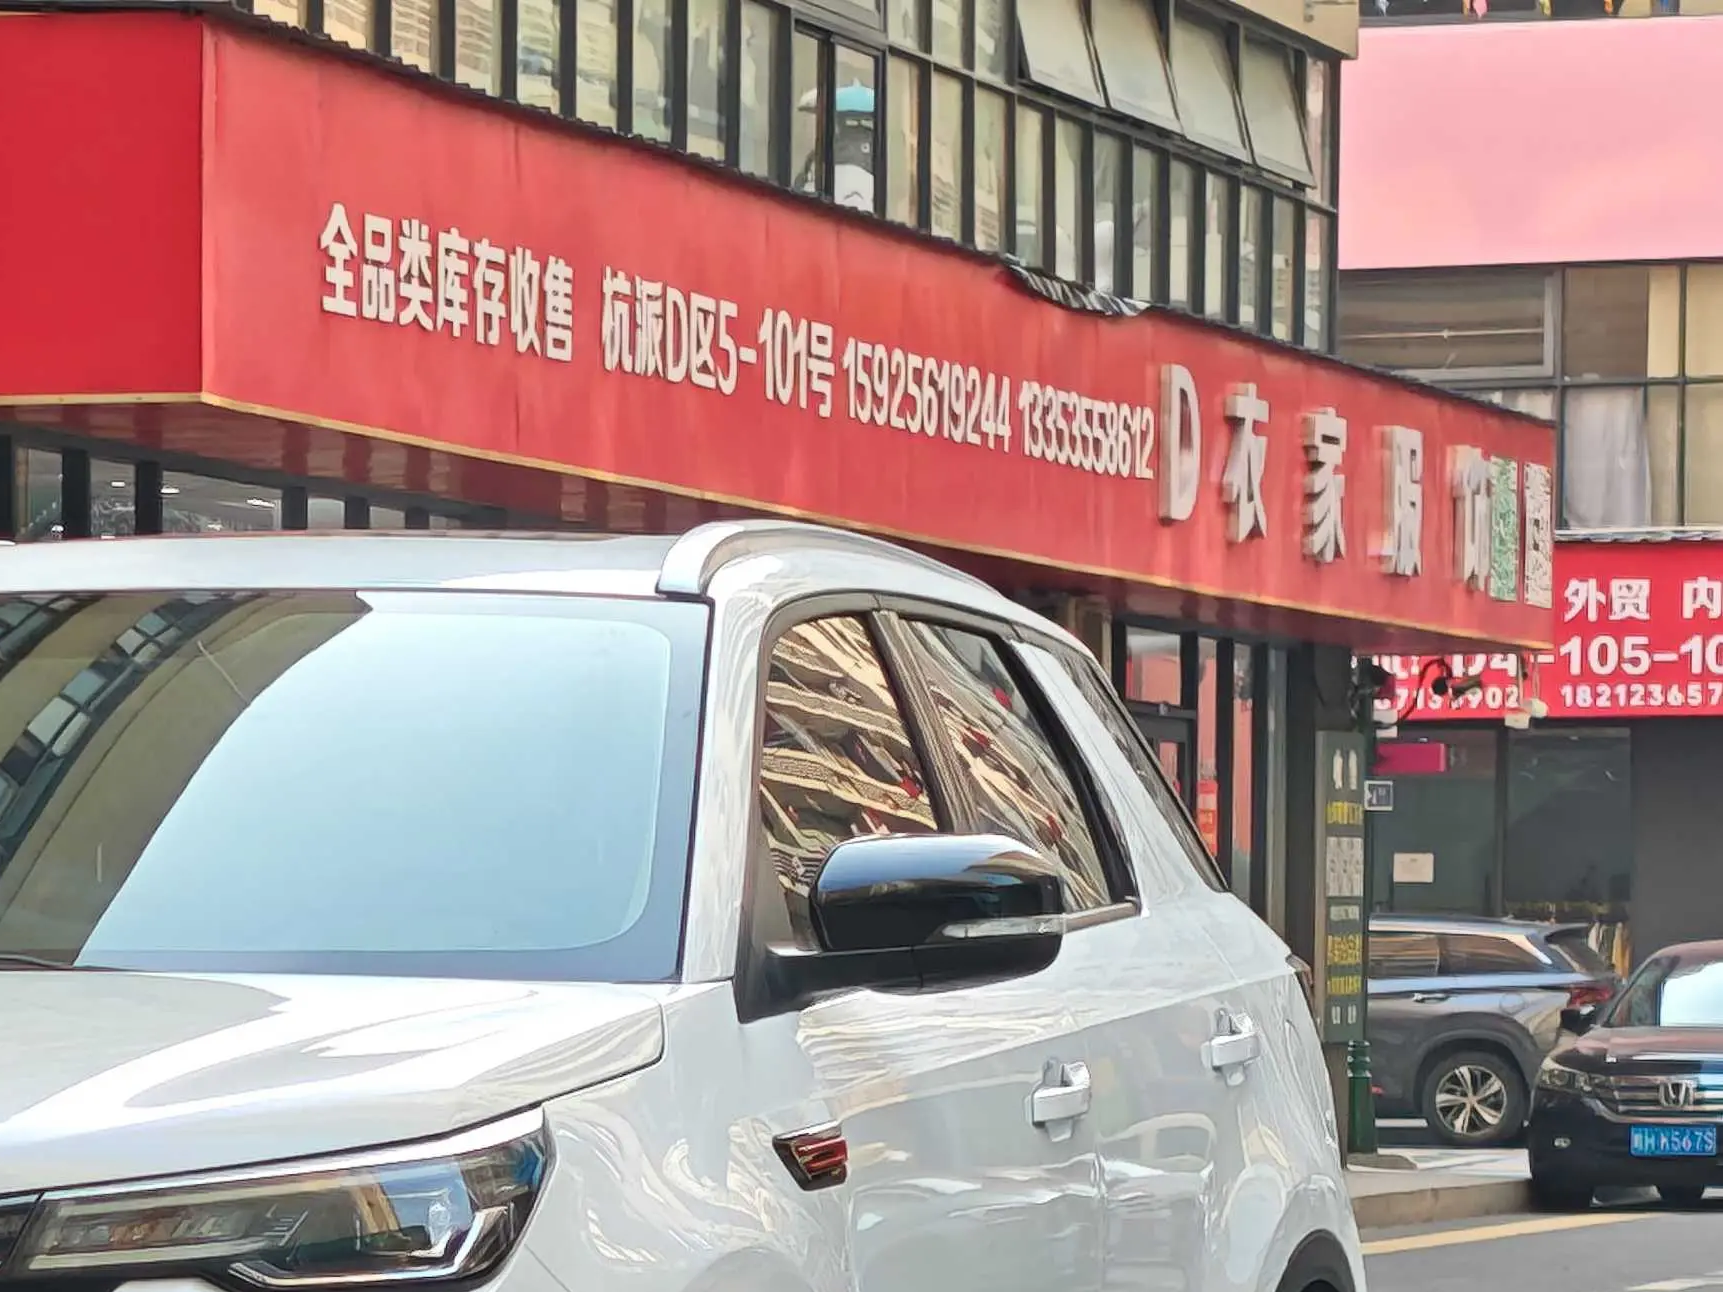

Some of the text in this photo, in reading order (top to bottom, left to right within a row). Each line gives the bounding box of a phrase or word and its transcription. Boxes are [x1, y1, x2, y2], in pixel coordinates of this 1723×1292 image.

[319, 201, 1155, 480] 全品类库存收售 杭派D区5-101号 15925619244 13353558612
[1563, 577, 1651, 622] 外贸
